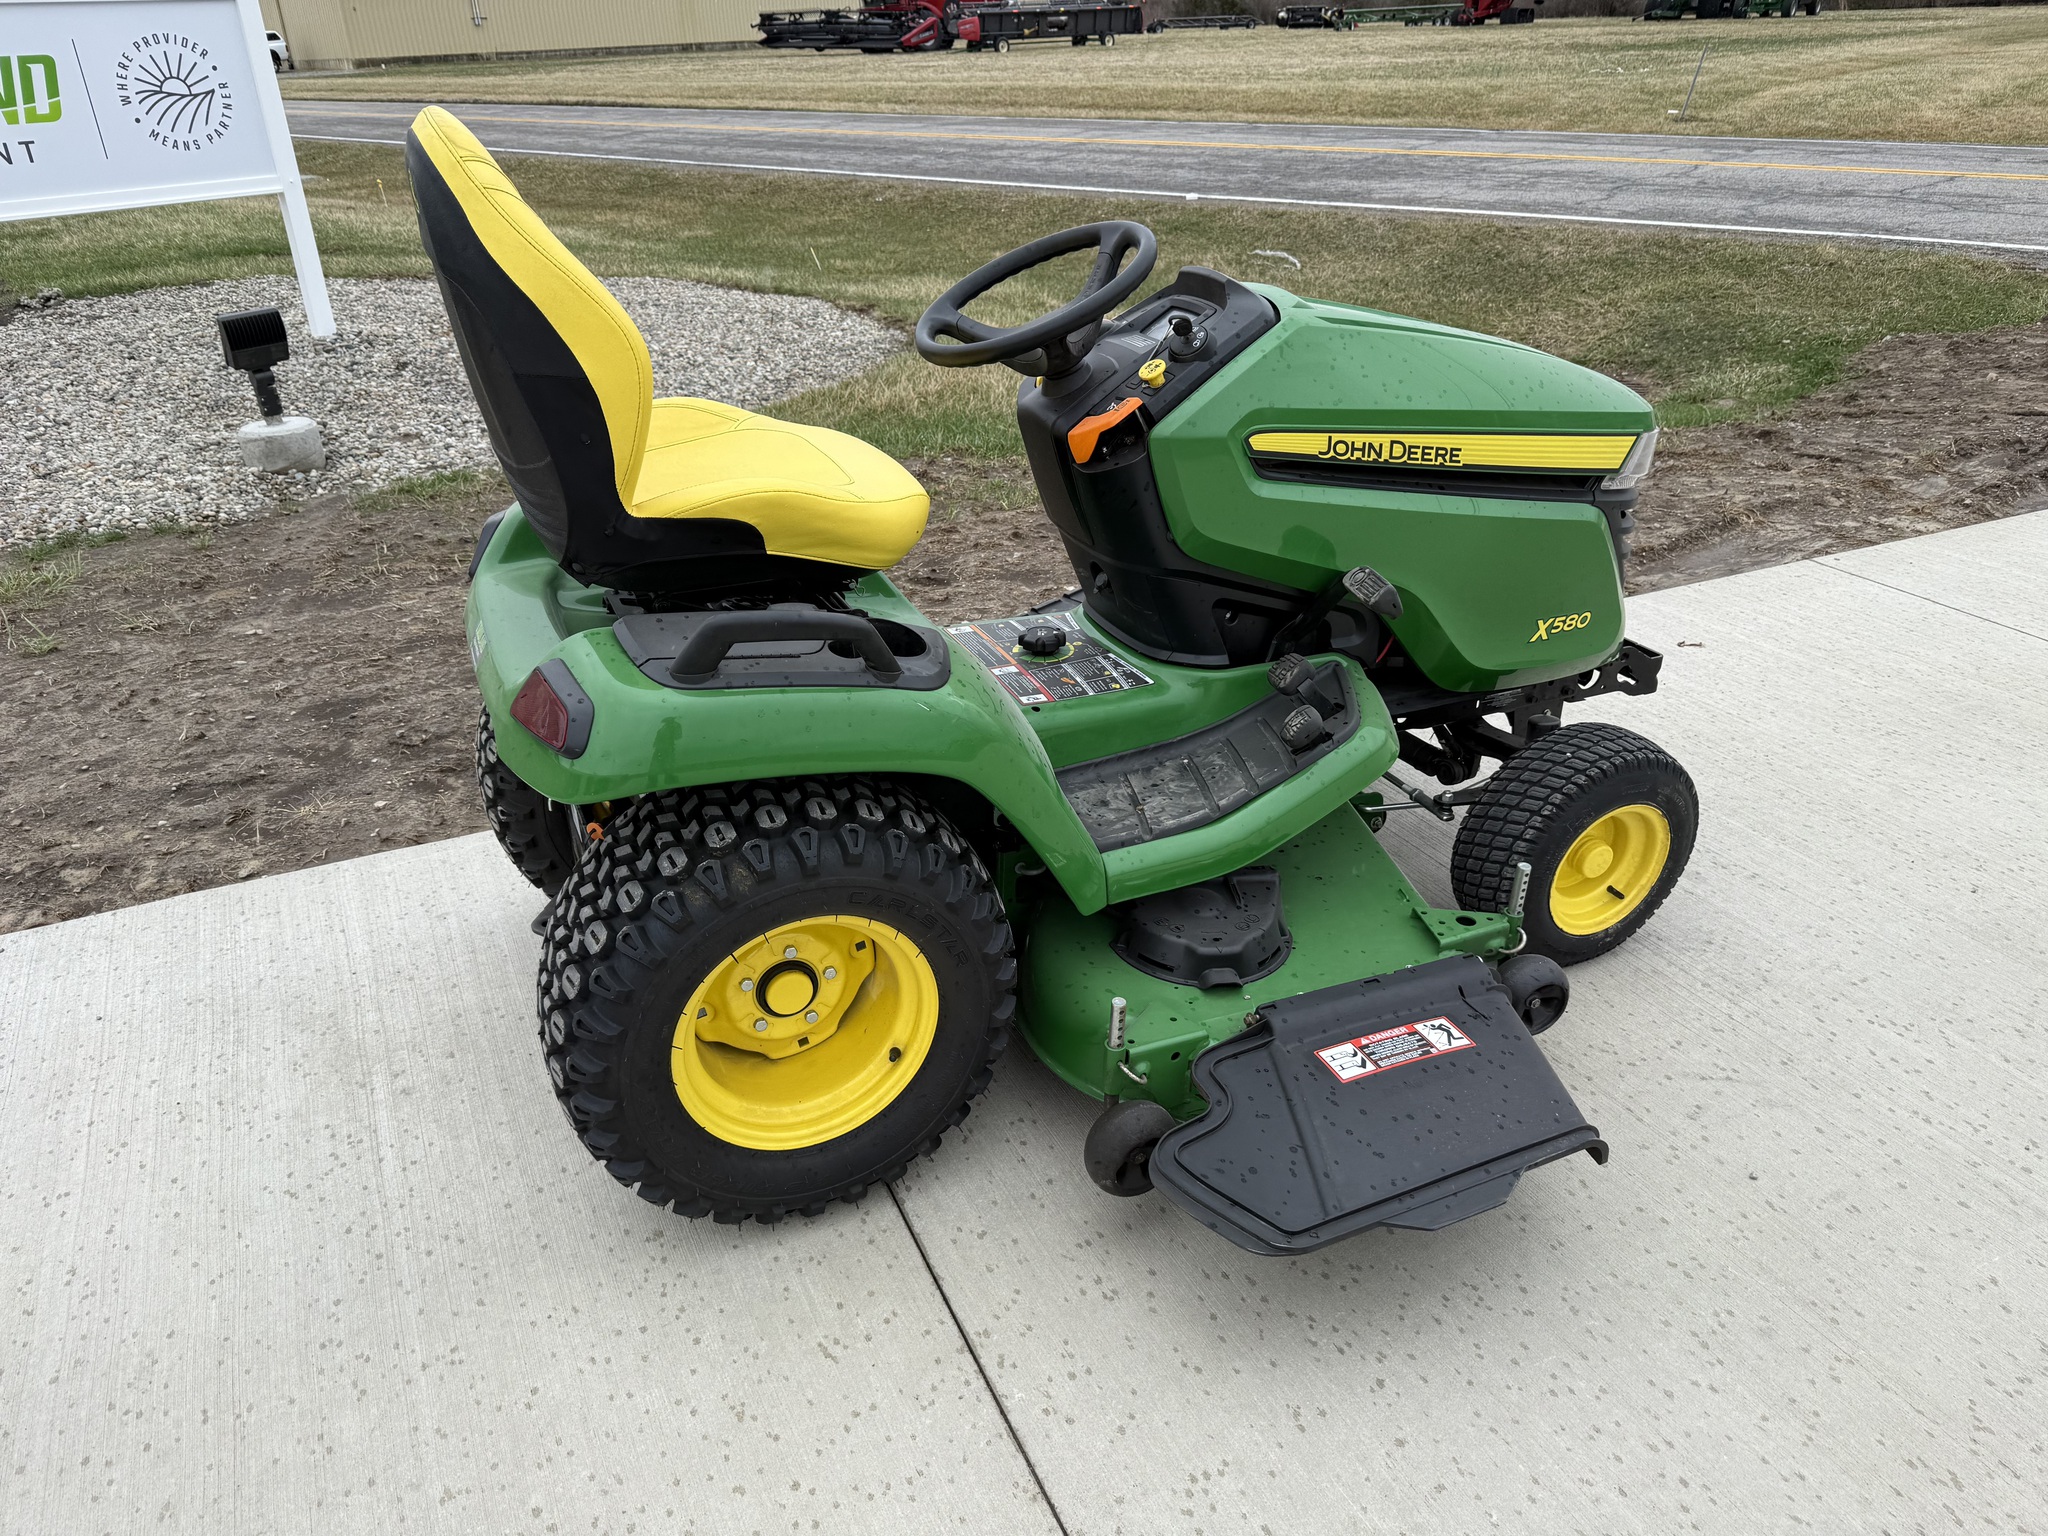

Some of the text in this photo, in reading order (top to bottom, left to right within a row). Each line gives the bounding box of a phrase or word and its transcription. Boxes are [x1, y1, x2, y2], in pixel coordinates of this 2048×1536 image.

[117, 33, 209, 106] WHERE PROVIDER
[149, 81, 232, 151] MEANS PARTNER
[1317, 435, 1463, 465] JOHN DEERE
[1527, 610, 1592, 643] X580
[848, 891, 969, 968] CARLSTAR
[1368, 1026, 1409, 1042] DANGER
